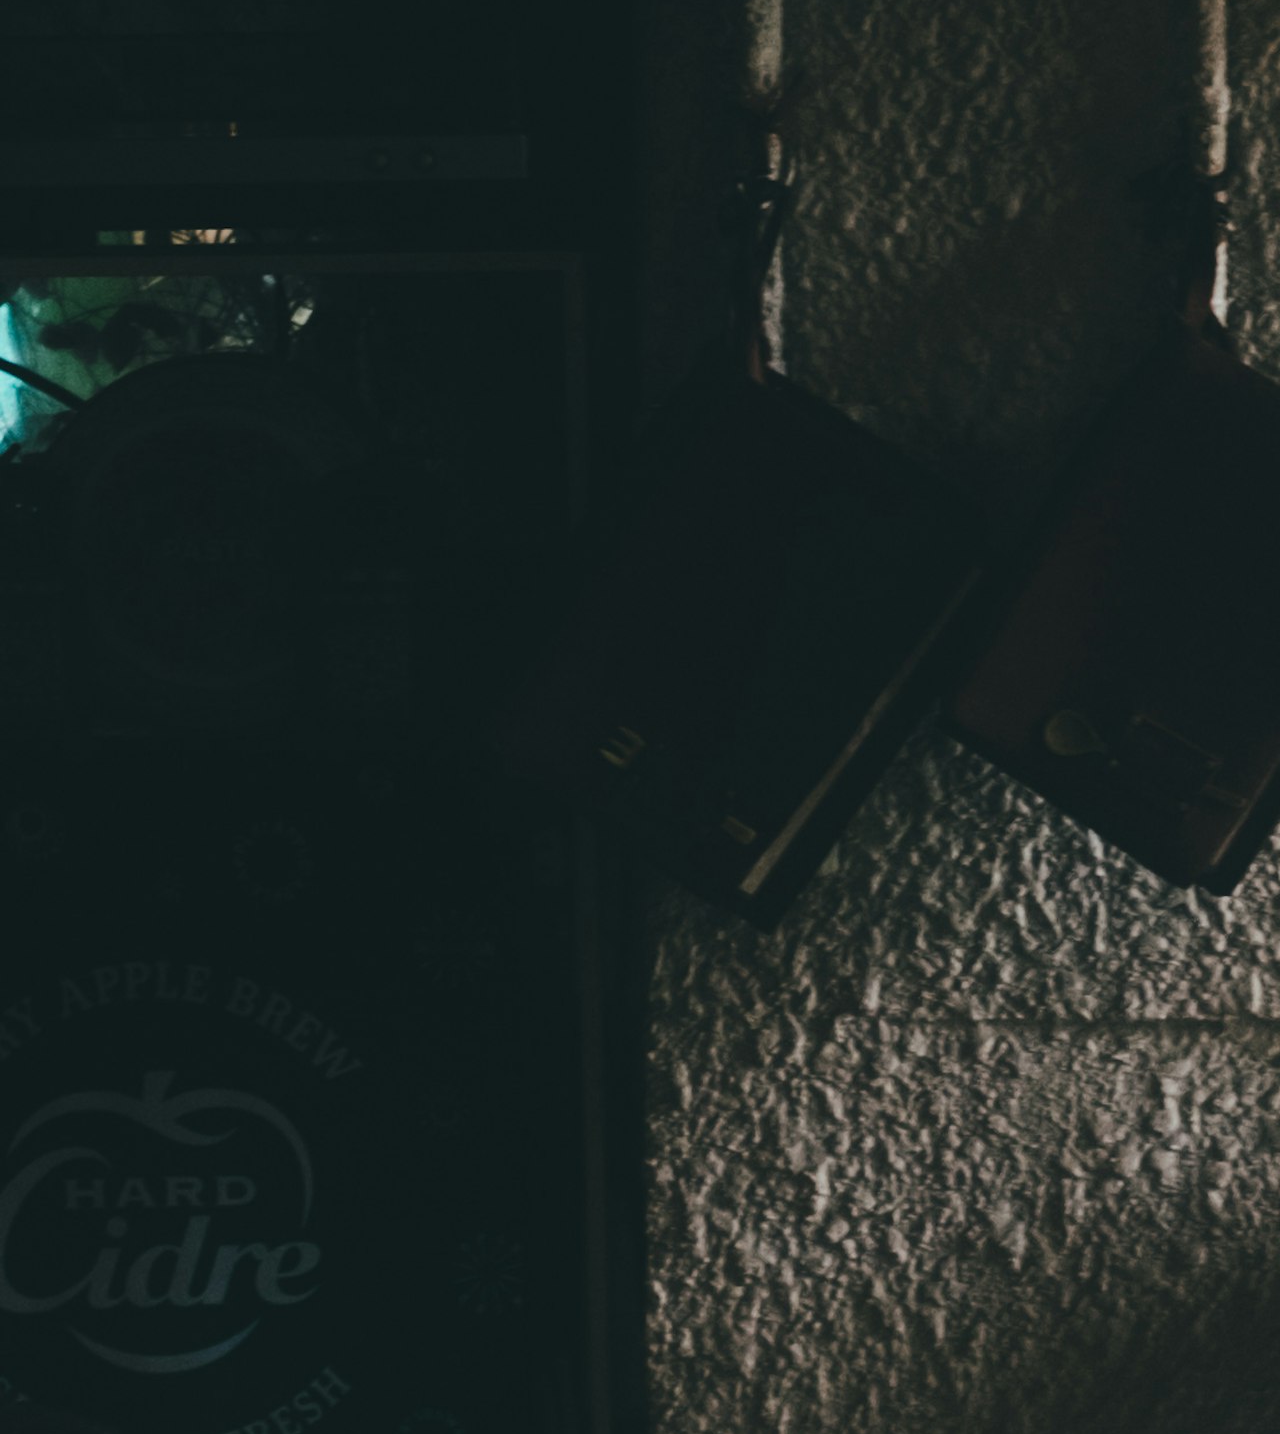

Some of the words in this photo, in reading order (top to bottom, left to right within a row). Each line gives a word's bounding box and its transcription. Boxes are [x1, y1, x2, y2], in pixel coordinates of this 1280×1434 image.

[61, 961, 211, 1018] APPLE
[226, 977, 364, 1080] BREW
[0, 1146, 322, 1314] Cidre
[65, 1175, 257, 1209] HARD
